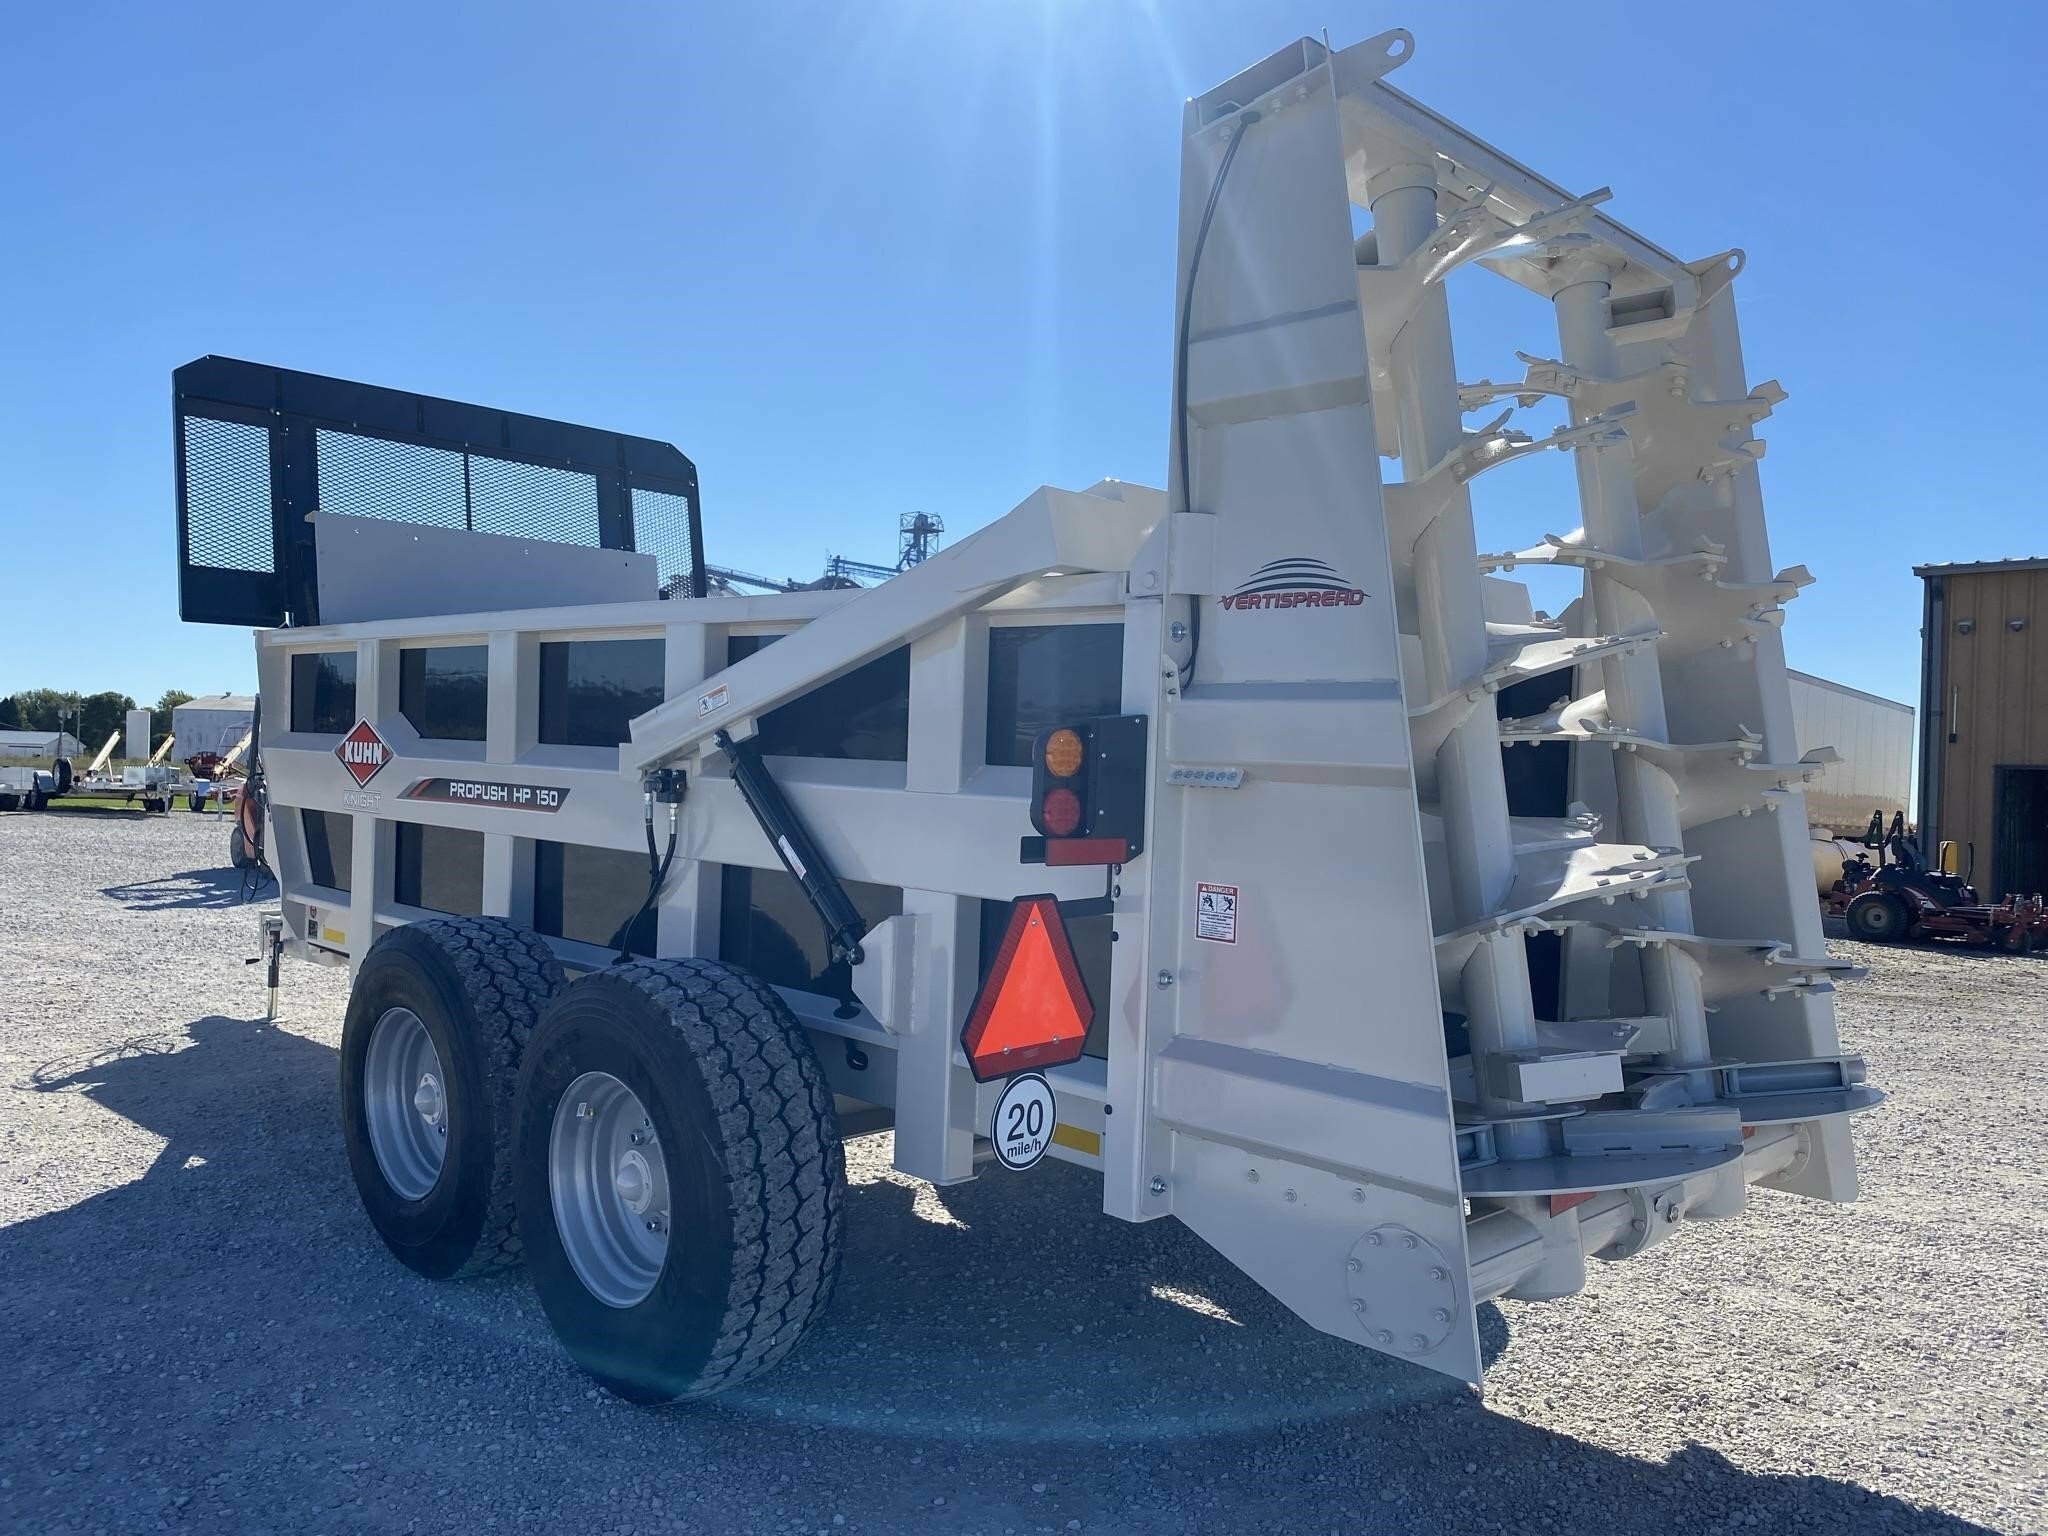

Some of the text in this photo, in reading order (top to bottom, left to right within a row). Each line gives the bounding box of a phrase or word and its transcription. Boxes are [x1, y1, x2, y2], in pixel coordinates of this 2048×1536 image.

[1221, 589, 1364, 611] VERTISPREAD
[344, 741, 383, 765] KUHN
[343, 791, 381, 809] KNIGHT
[450, 782, 558, 807] PROPUSH HP 150
[1208, 885, 1234, 894] DANGER
[1007, 1099, 1043, 1142] 20
[1007, 1138, 1041, 1158] mile/h
